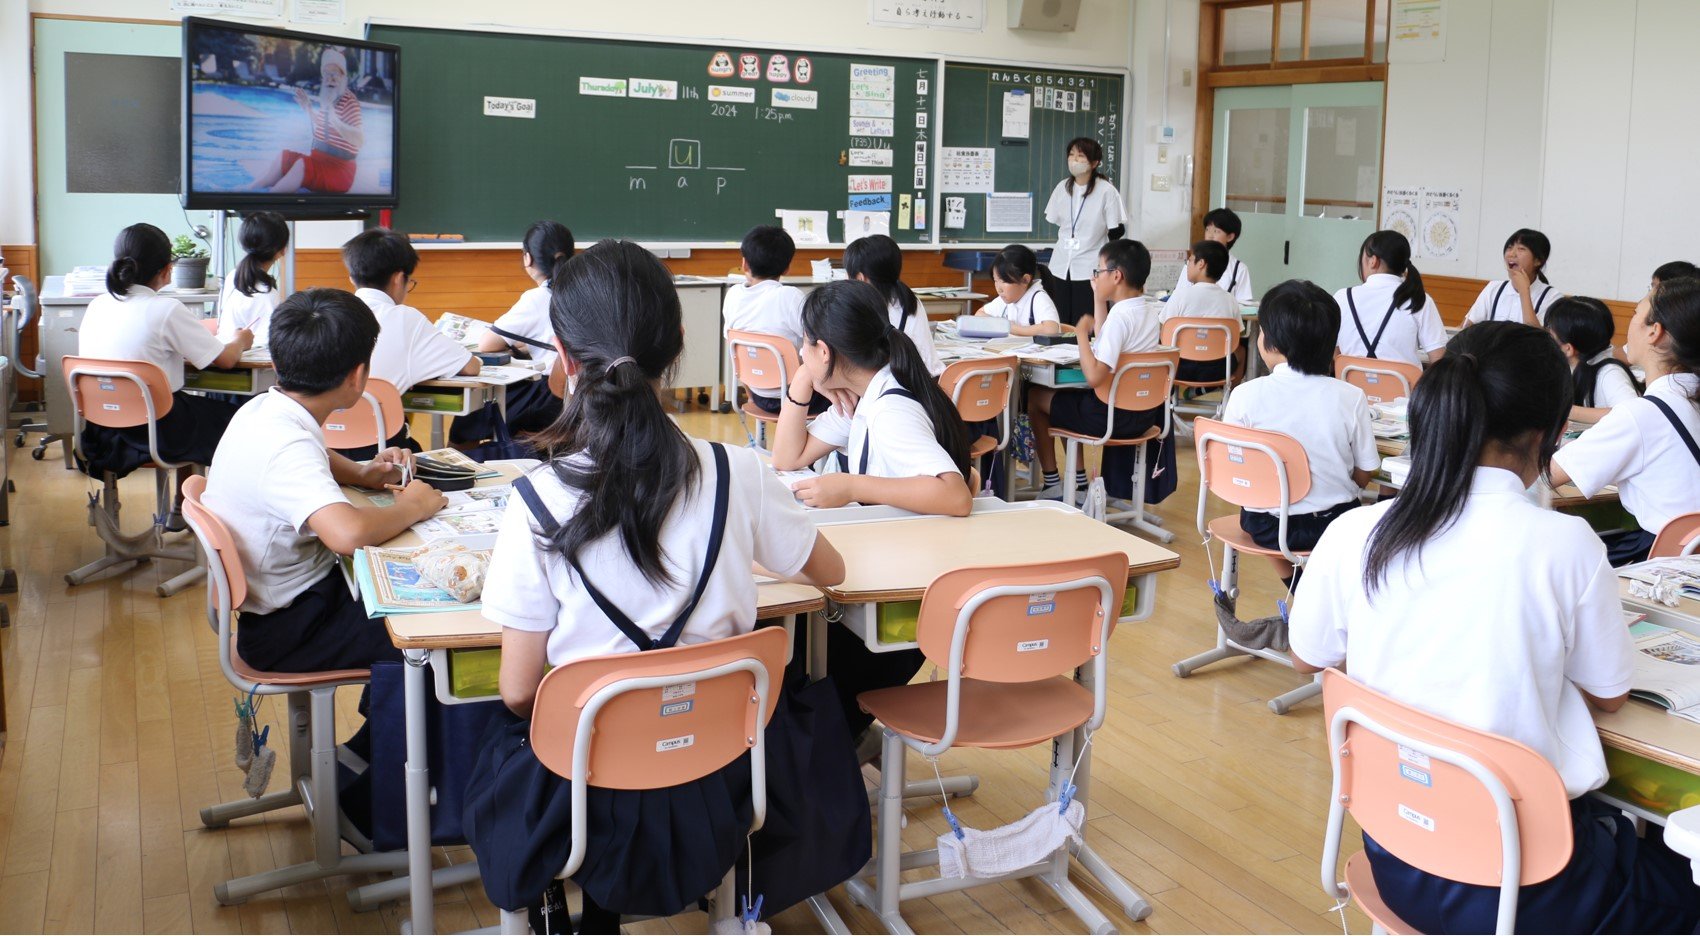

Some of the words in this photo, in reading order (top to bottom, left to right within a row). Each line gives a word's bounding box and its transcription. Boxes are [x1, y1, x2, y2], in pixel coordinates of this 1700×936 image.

[853, 68, 889, 77] Greeting
[992, 72, 1031, 83] れんらく
[1035, 75, 1042, 84] 6
[1046, 76, 1053, 85] 5
[1057, 77, 1064, 85] 4
[1068, 78, 1075, 86] 3
[1079, 79, 1085, 87] 2
[634, 83, 659, 97] July
[682, 85, 699, 99] 11th
[722, 90, 753, 98] summer
[791, 95, 815, 103] cloudy
[487, 101, 514, 111] Today's
[516, 102, 533, 111] Goal
[711, 103, 738, 117] 2024
[629, 177, 646, 190] m
[677, 176, 689, 188] a
[716, 177, 727, 195] p
[869, 179, 886, 191] Write
[850, 196, 885, 208] Feedback
